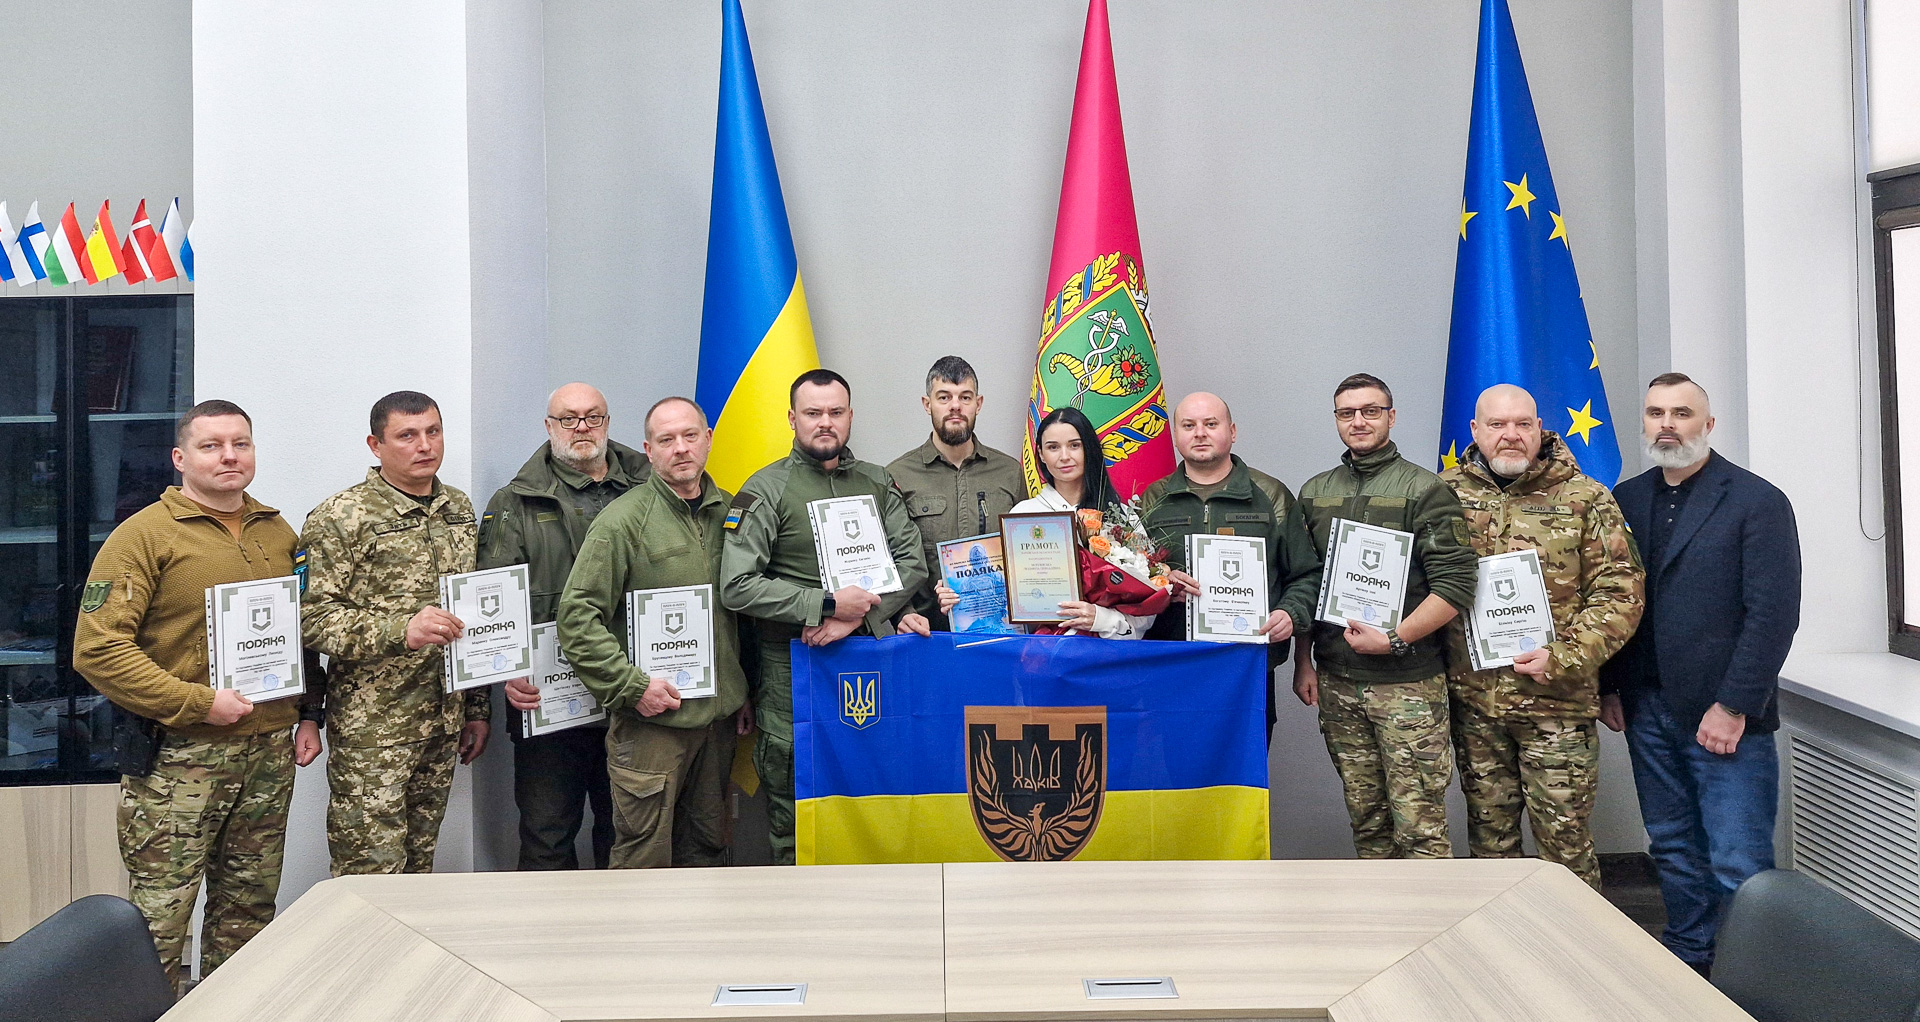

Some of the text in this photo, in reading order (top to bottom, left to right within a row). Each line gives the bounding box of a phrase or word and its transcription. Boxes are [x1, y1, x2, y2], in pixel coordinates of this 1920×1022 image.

[1023, 448, 1040, 499] ОБЛАС
[836, 543, 876, 557] ПОДЯКА
[1020, 542, 1060, 551] ГРАМОТА
[956, 564, 1004, 579] ПОДЯКА
[1346, 571, 1391, 591] ПОДЯКА
[1209, 585, 1254, 597] ПОДЯКА
[1486, 604, 1536, 619] ПОДЯКА
[467, 620, 516, 637] ПОДЯКА
[237, 635, 286, 652] ПОДЯКА
[651, 639, 698, 652] ПОДЯКА
[544, 670, 577, 684] ПОДЯ
